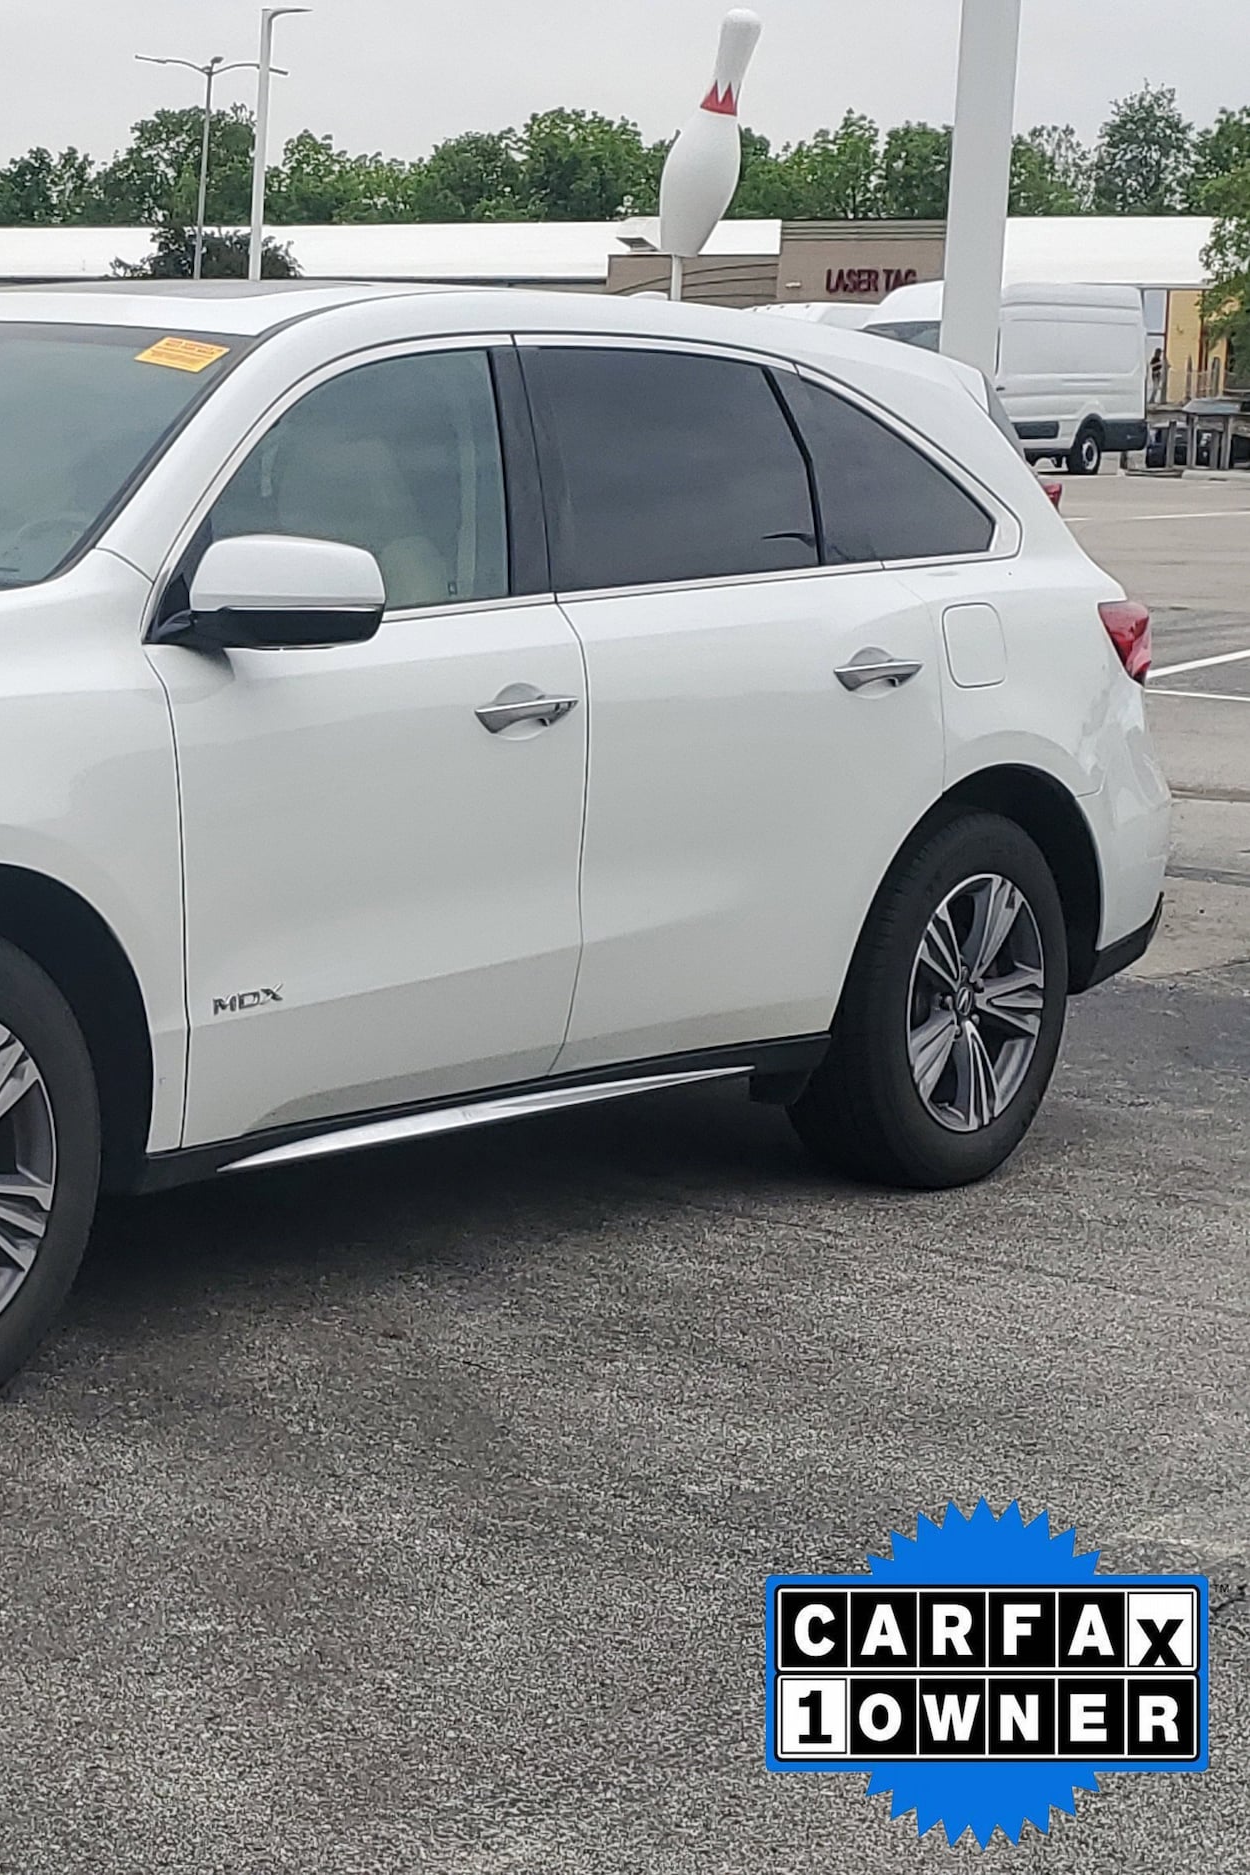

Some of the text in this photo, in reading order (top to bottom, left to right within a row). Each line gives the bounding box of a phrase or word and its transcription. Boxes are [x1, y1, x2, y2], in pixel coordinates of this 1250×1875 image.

[826, 269, 917, 293] LASER TAG
[213, 983, 283, 1016] MDX
